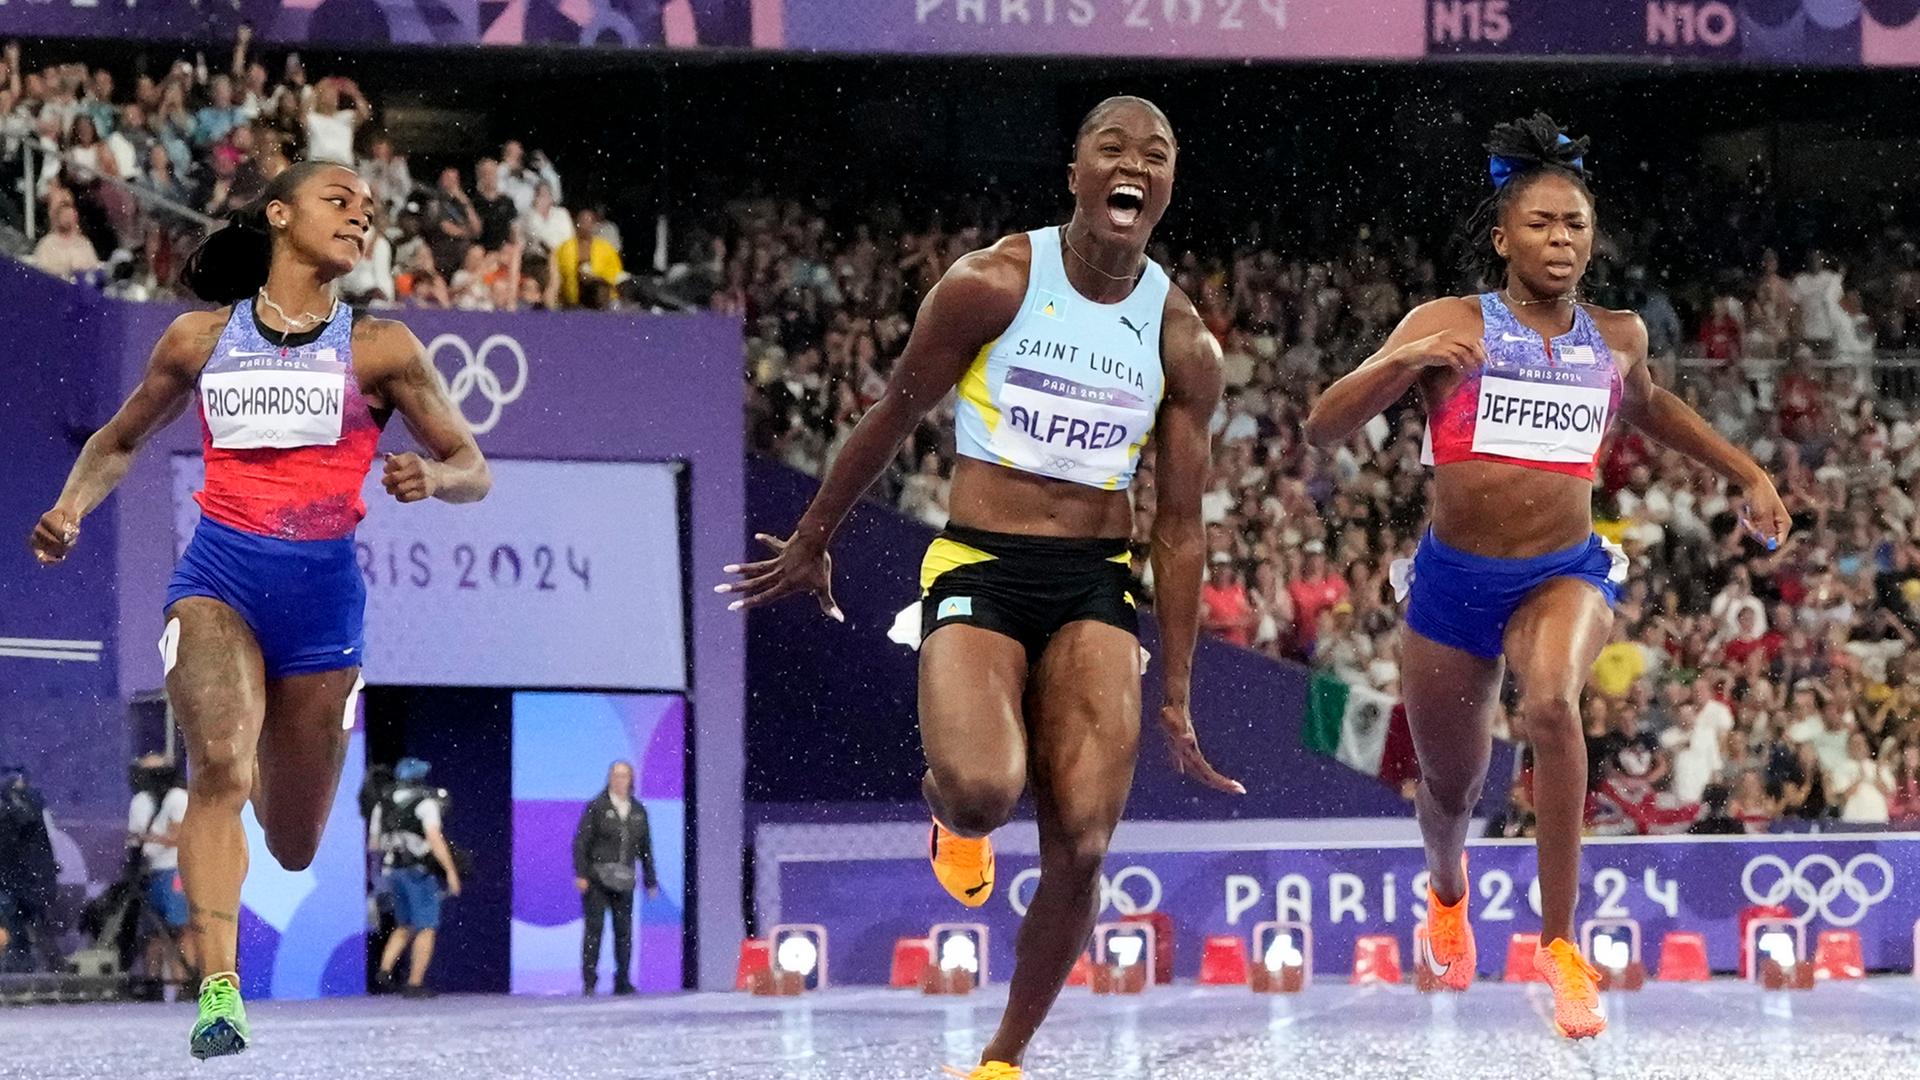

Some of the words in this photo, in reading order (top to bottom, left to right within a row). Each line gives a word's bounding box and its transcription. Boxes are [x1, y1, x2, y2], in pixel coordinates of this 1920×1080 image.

[1432, 0, 1511, 42] N15
[1646, 1, 1736, 46] N10
[276, 359, 309, 369] 2024
[1016, 338, 1079, 363] SAINT
[1090, 352, 1144, 390] LUCIA
[1519, 368, 1552, 380] PARIS
[1555, 372, 1582, 383] 2024
[206, 386, 339, 417] RICHARDSON
[1043, 378, 1077, 396] PARIS
[1080, 388, 1114, 400] 2024
[1010, 405, 1128, 450] ALFRED
[1481, 392, 1604, 434] JEFFERSON
[355, 541, 432, 588] RIS
[455, 543, 591, 592] 2024
[1478, 867, 1679, 921] 224
